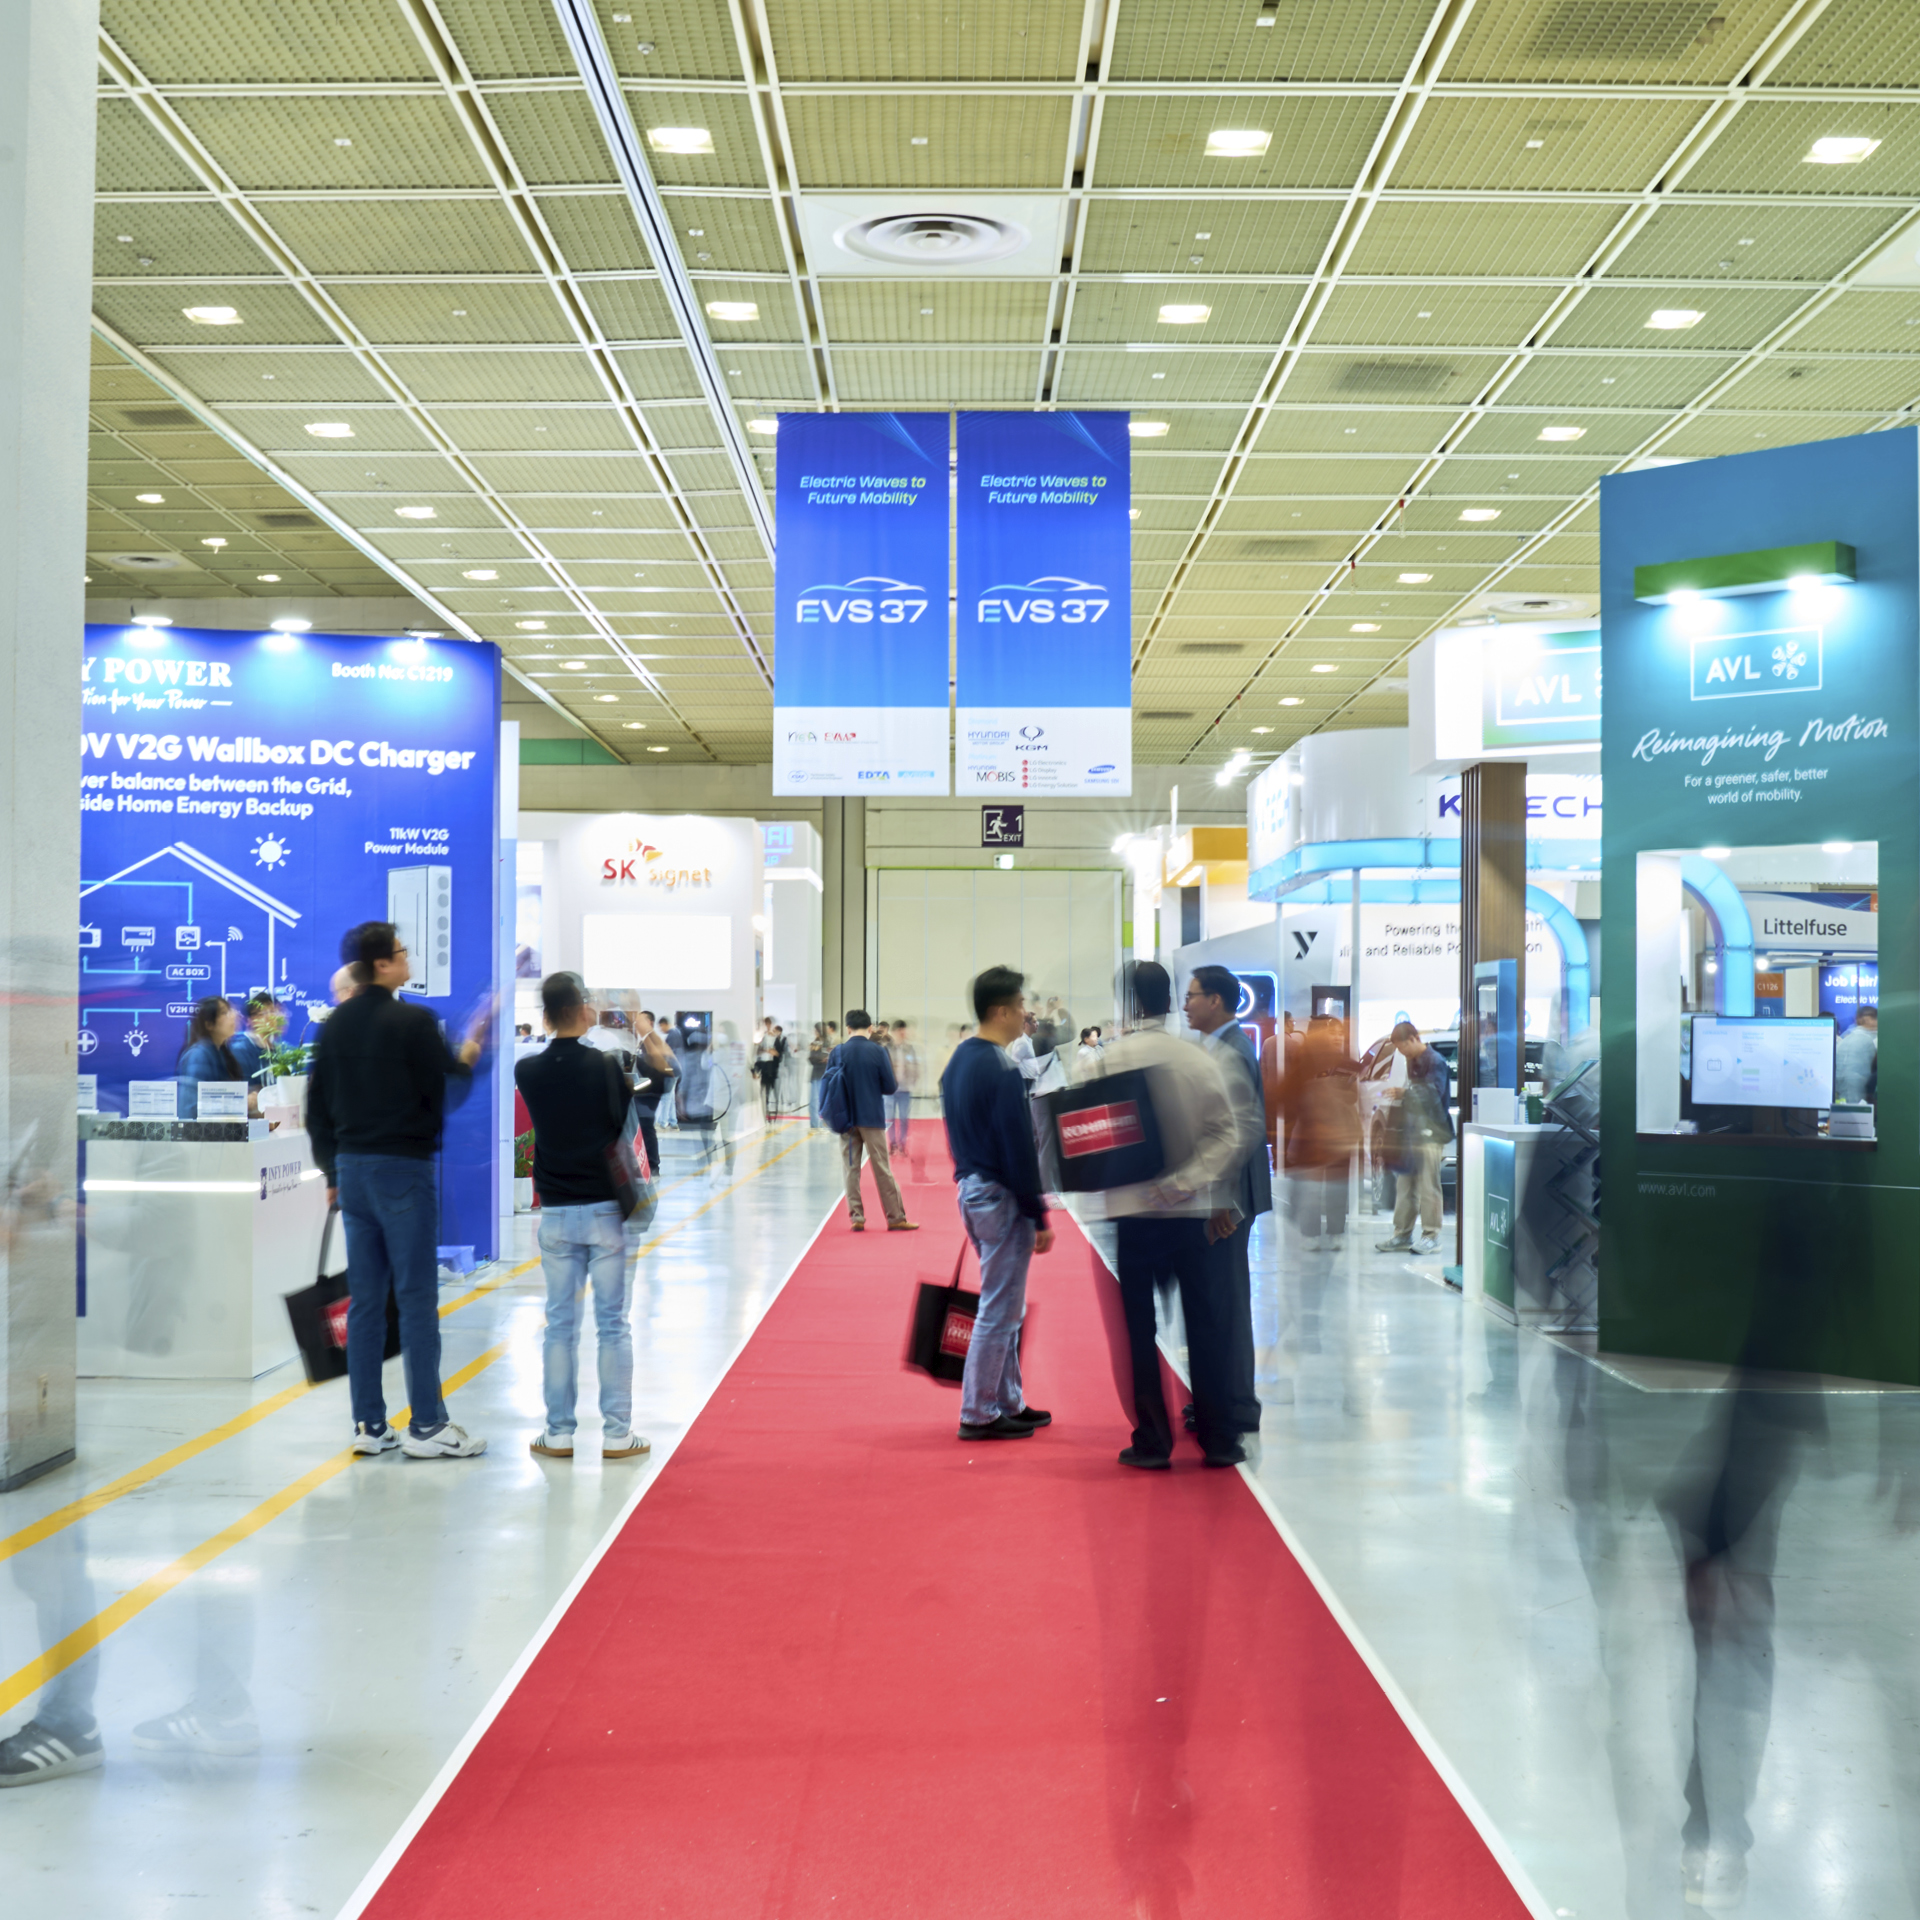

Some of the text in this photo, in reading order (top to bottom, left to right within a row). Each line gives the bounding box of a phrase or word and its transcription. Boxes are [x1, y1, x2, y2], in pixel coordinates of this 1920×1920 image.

[800, 475, 926, 488] Electric Waves to
[980, 474, 1107, 487] Electric Waves to
[807, 491, 918, 506] Future Mobility
[988, 490, 1099, 505] Future Mobility
[796, 599, 928, 623] EVS 37
[978, 599, 1109, 623] EVS 37
[103, 657, 233, 687] POWER
[332, 662, 376, 679] Booth
[406, 665, 453, 682] C1219
[1705, 655, 1761, 683] AVL
[163, 688, 208, 709] Power
[1514, 674, 1582, 706] AVL
[968, 731, 1010, 739] HYUNDAI
[1632, 713, 1888, 766] Reimagining Motion
[115, 732, 183, 761] V2G
[186, 735, 306, 765] Wallbox
[310, 739, 355, 766] DC
[358, 740, 477, 776] Charger
[111, 771, 186, 791] balance
[189, 773, 269, 793] between
[271, 775, 303, 794] the
[305, 777, 352, 797] Grid,
[976, 771, 1016, 783] MOBIS
[1685, 768, 1828, 788] For a greener, safer, better
[1708, 788, 1803, 804] world of mobility.
[118, 794, 174, 813] Home
[177, 796, 243, 819] Energy
[246, 797, 314, 820] Backup
[1015, 814, 1023, 832] 1
[389, 827, 450, 841] 11kW V2G
[1003, 834, 1021, 842] EXIT
[364, 841, 450, 855] Power Module
[603, 858, 711, 887] SK signet
[1385, 923, 1441, 937] Powering
[1763, 918, 1848, 936] Littelfuse
[1366, 944, 1388, 957] and
[1392, 942, 1443, 956] Reliable
[1825, 974, 1849, 987] Job
[296, 990, 307, 998] PV
[170, 1005, 187, 1013] V2H
[269, 1161, 302, 1181] INFY POWER
[1637, 1182, 1716, 1198] www.avl.com
[1490, 1211, 1500, 1233] AVL
